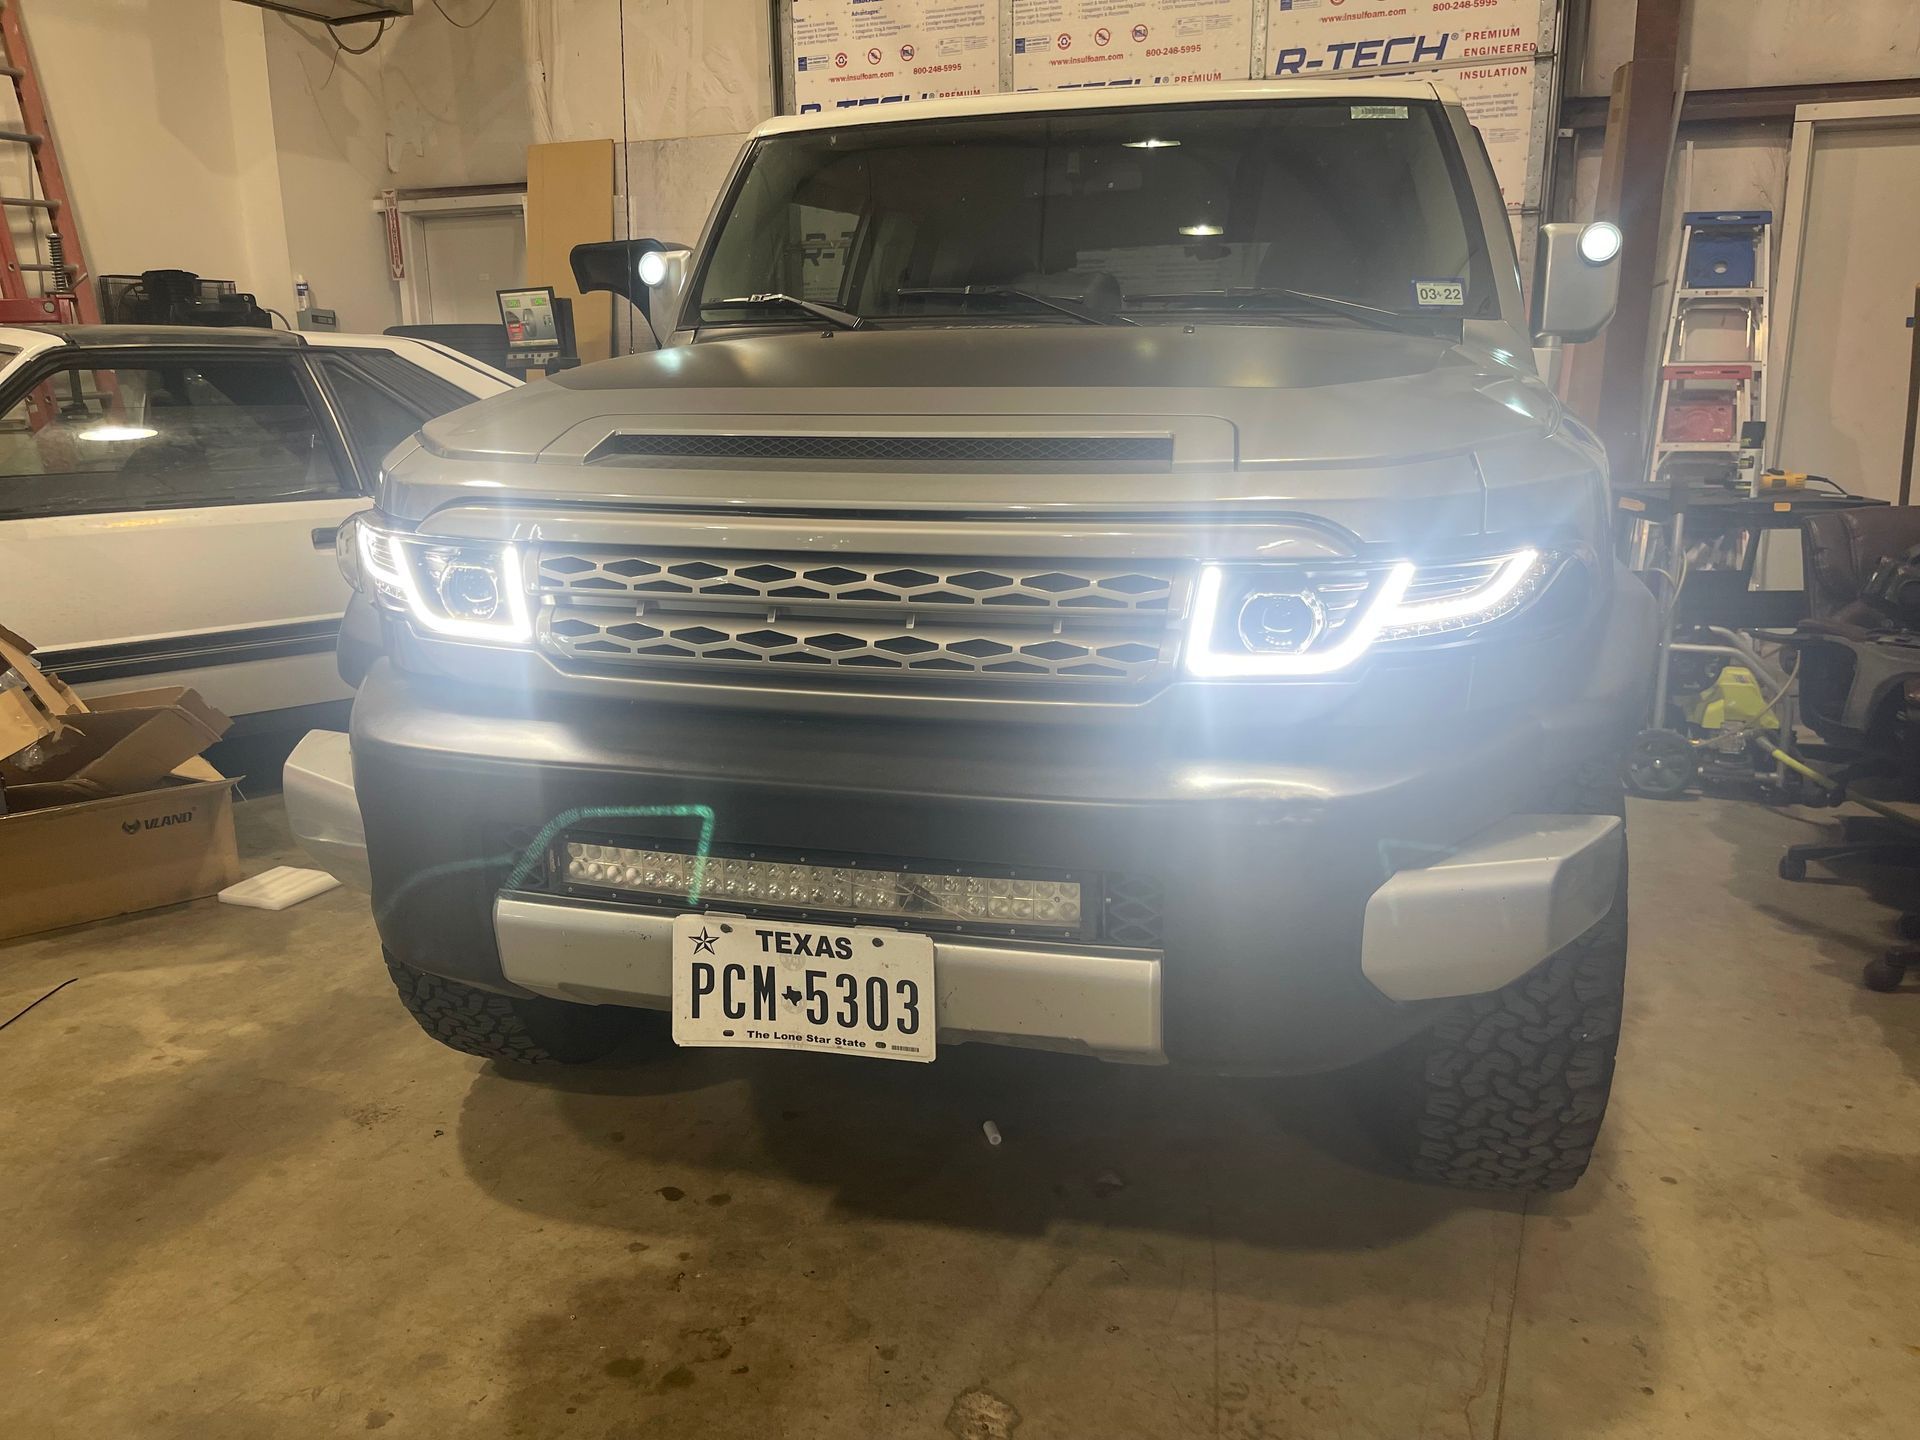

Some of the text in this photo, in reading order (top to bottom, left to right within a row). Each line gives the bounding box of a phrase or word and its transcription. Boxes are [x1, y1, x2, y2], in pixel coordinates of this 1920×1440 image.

[1432, 0, 1498, 12] 800-248-5995
[1320, 8, 1407, 23] www.insulfoam.com
[1465, 27, 1521, 41] PREMIUM
[1145, 44, 1202, 58] 800-248-5995
[1464, 42, 1537, 57] ENGINEERED
[1049, 52, 1124, 67] www.insulfoam.com
[913, 63, 962, 75] 800-248-5995
[1460, 66, 1528, 80] INSULATION
[829, 71, 895, 84] www.insulfoam.com
[1174, 72, 1222, 84] PREMIUM
[1420, 288, 1462, 300] 03 22
[144, 811, 193, 830] VLAND
[755, 929, 853, 960] TEXAS
[691, 962, 919, 1035] PCM 5303
[747, 1030, 866, 1048] The Lone Star State
